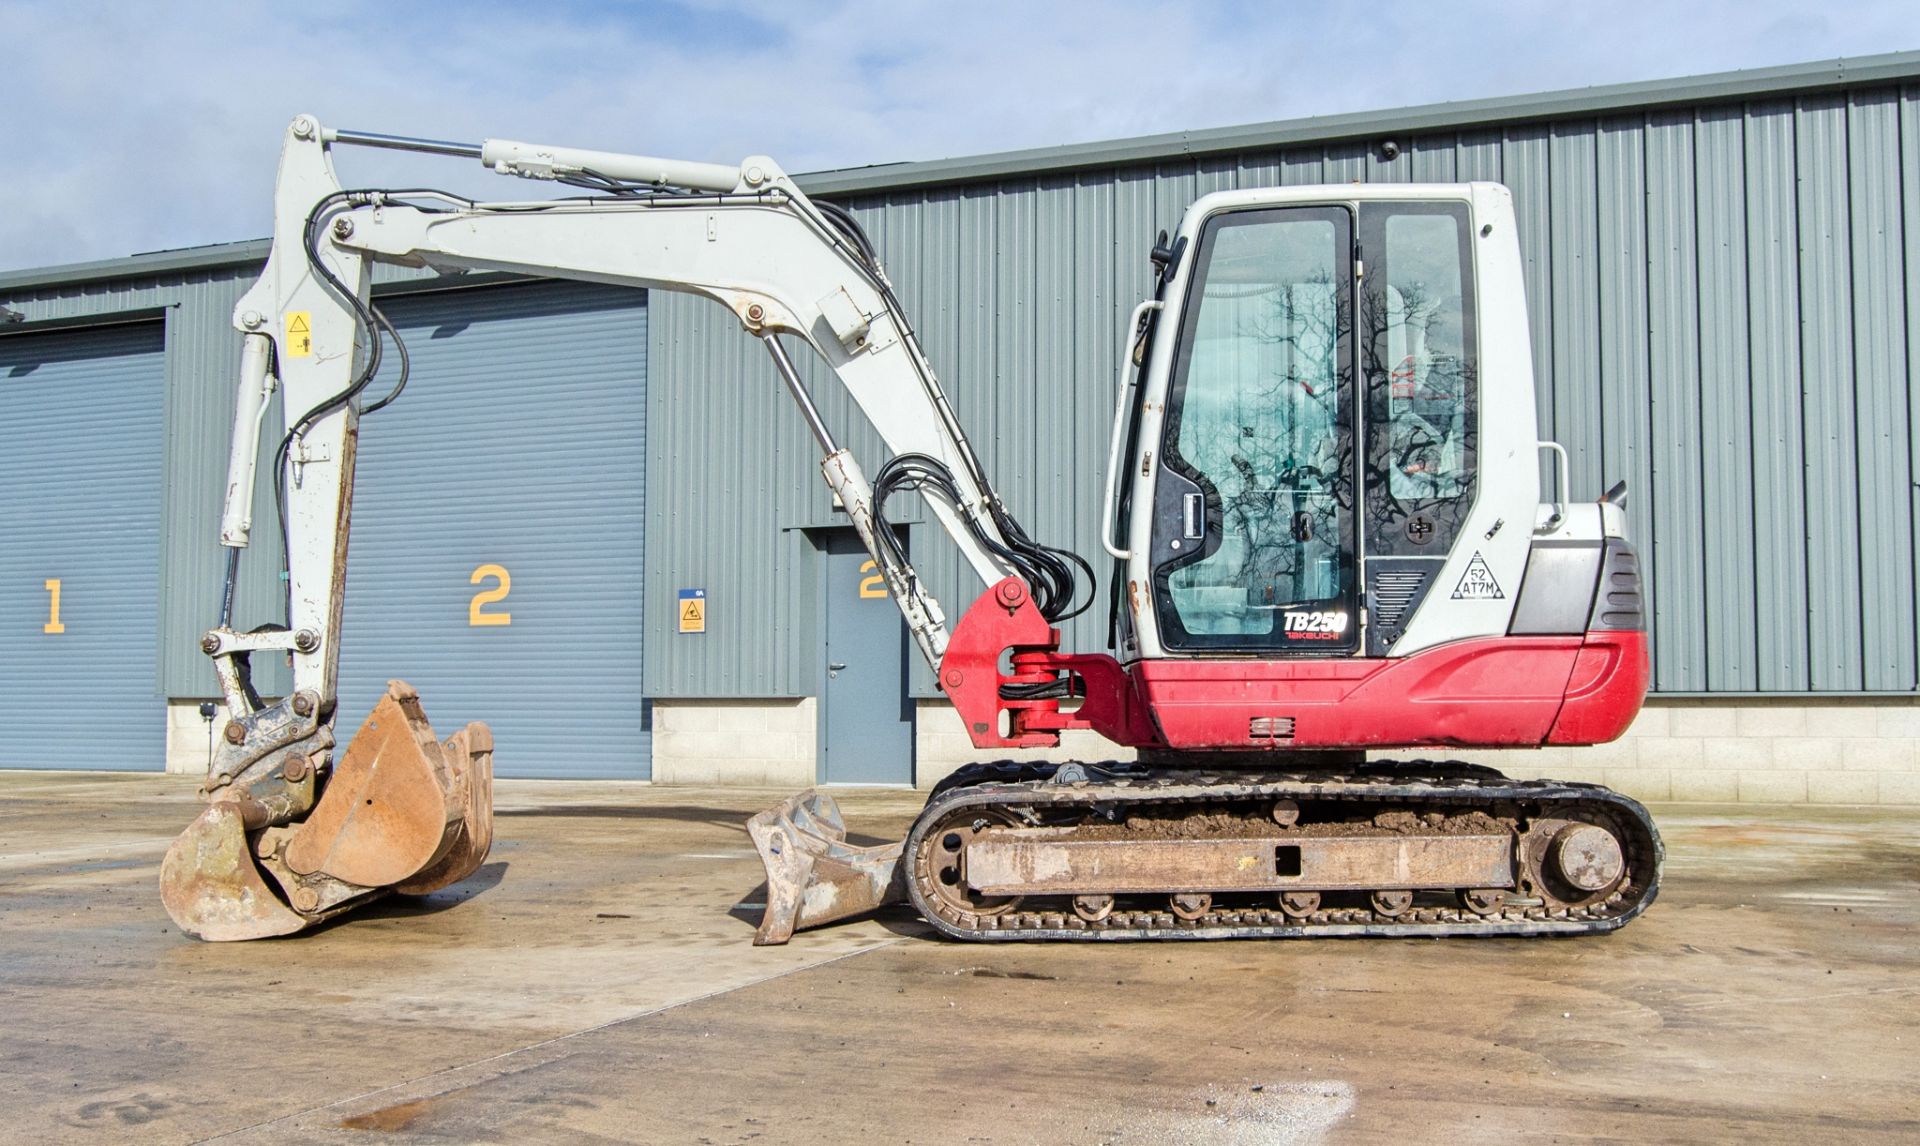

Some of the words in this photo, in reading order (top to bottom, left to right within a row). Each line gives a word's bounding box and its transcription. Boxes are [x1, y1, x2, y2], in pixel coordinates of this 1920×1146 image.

[860, 560, 888, 598] 2
[1463, 582, 1494, 594] AT7M
[1470, 568, 1486, 581] 52
[44, 579, 65, 633] 1
[470, 564, 511, 625] 2
[1284, 611, 1348, 633] TB250
